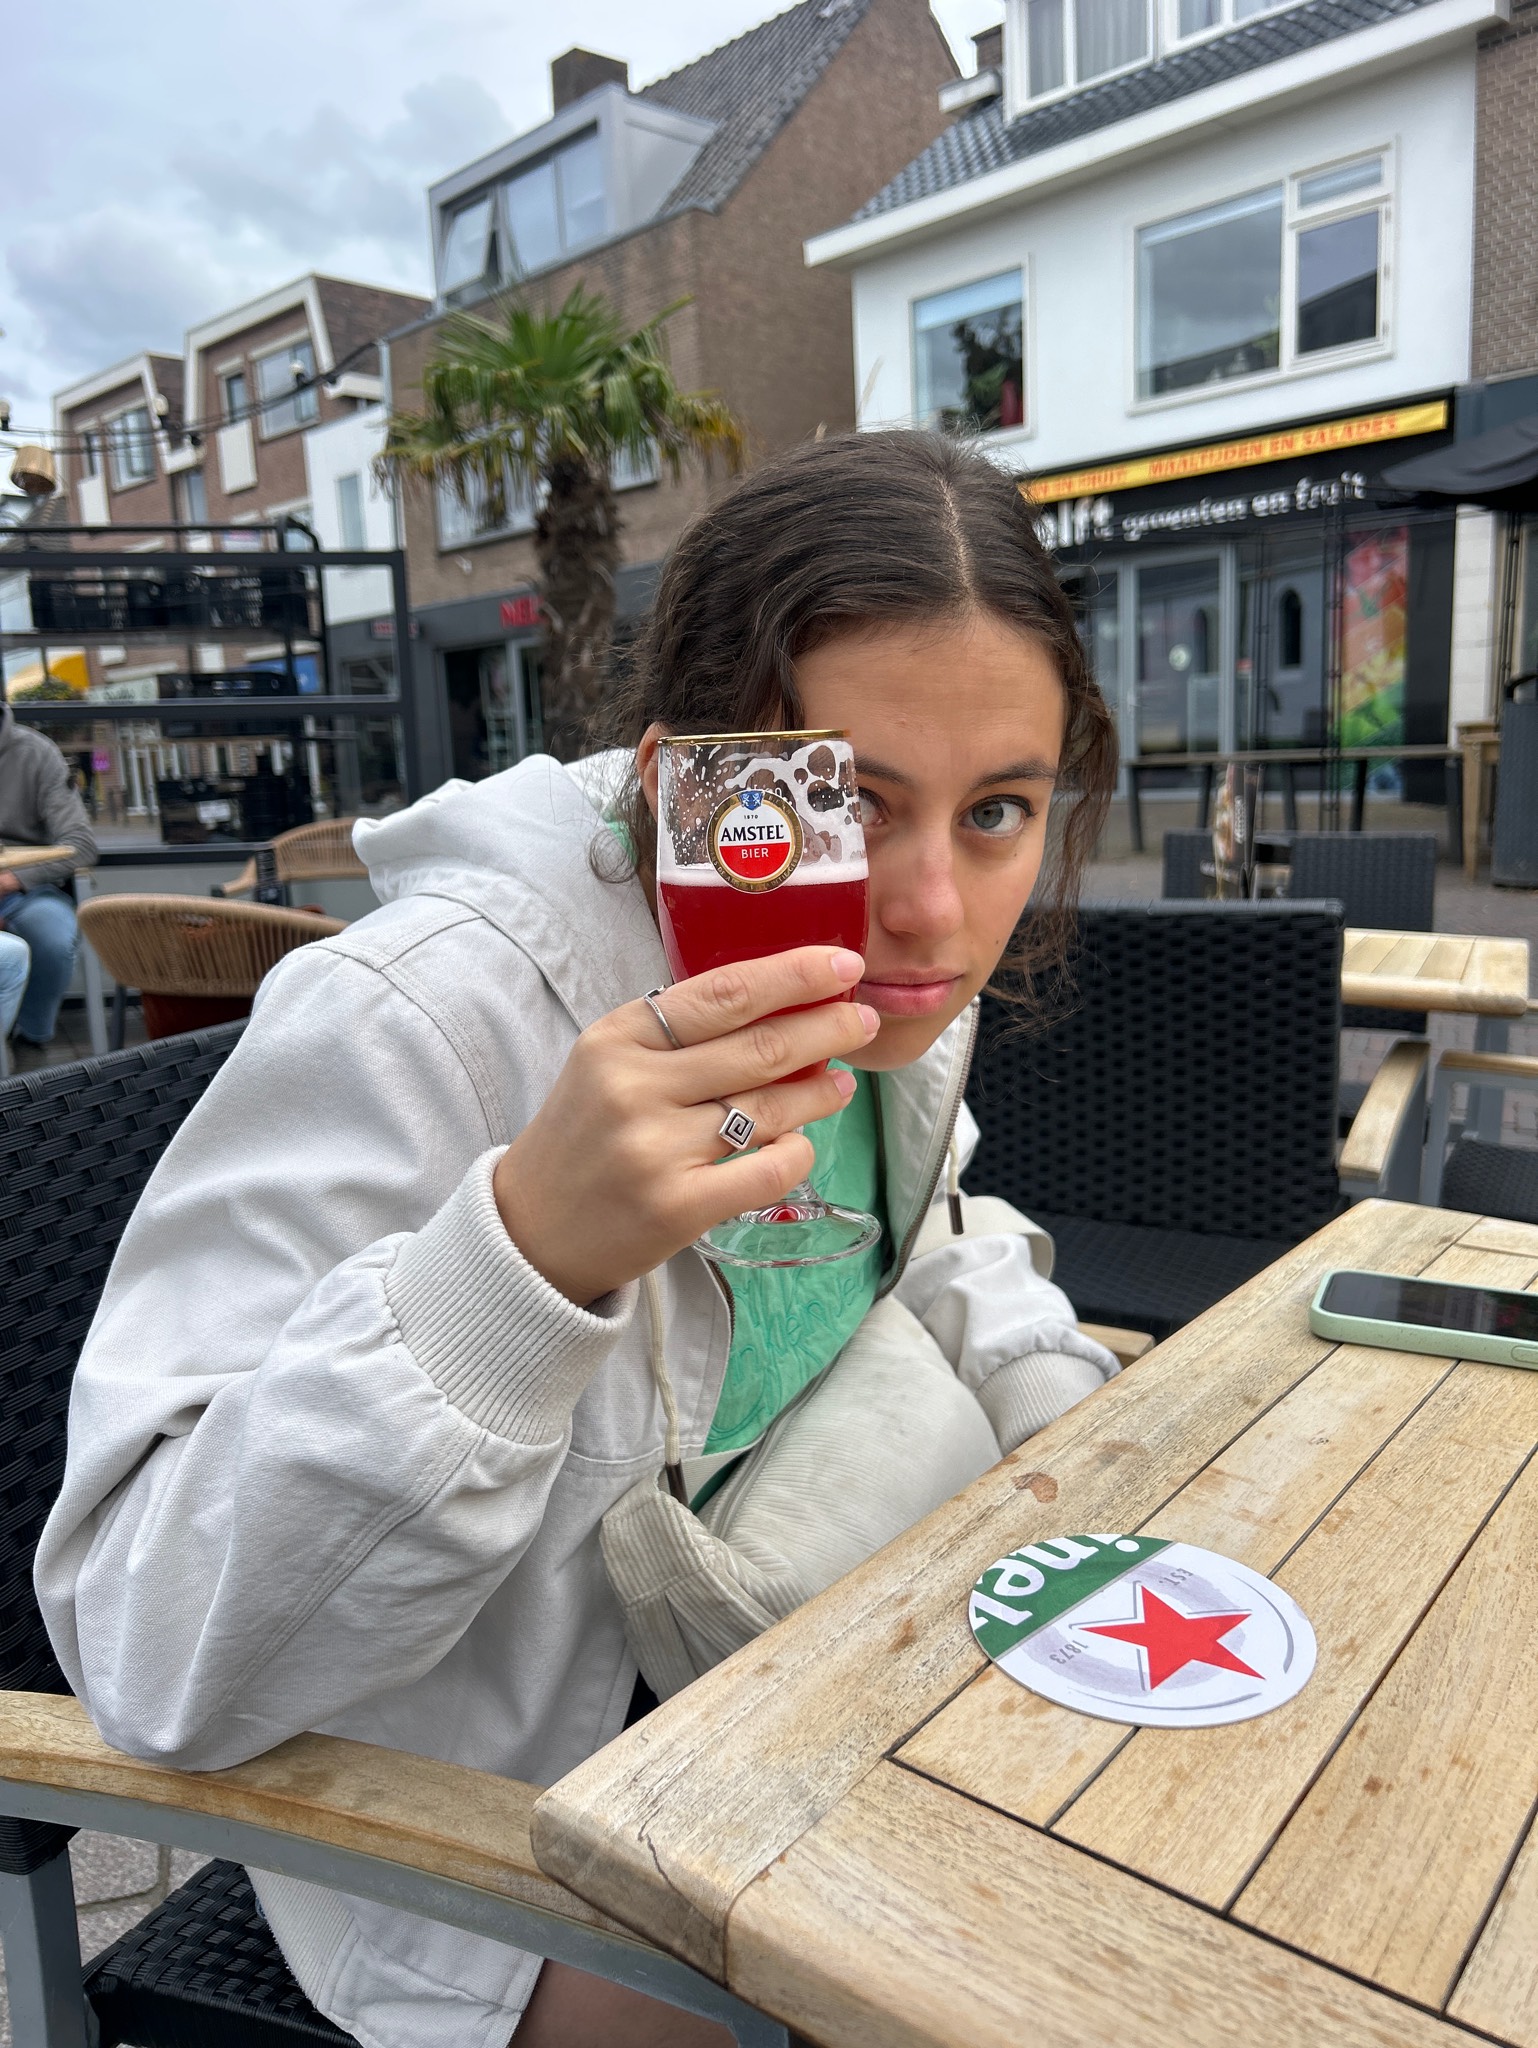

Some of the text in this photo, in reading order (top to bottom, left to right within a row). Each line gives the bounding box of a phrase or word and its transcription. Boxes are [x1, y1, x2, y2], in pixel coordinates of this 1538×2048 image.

[720, 824, 785, 842] AMSTEL
[741, 847, 769, 859] BIER
[1158, 1567, 1194, 1586] EST.
[1049, 1639, 1089, 1665] 1873
